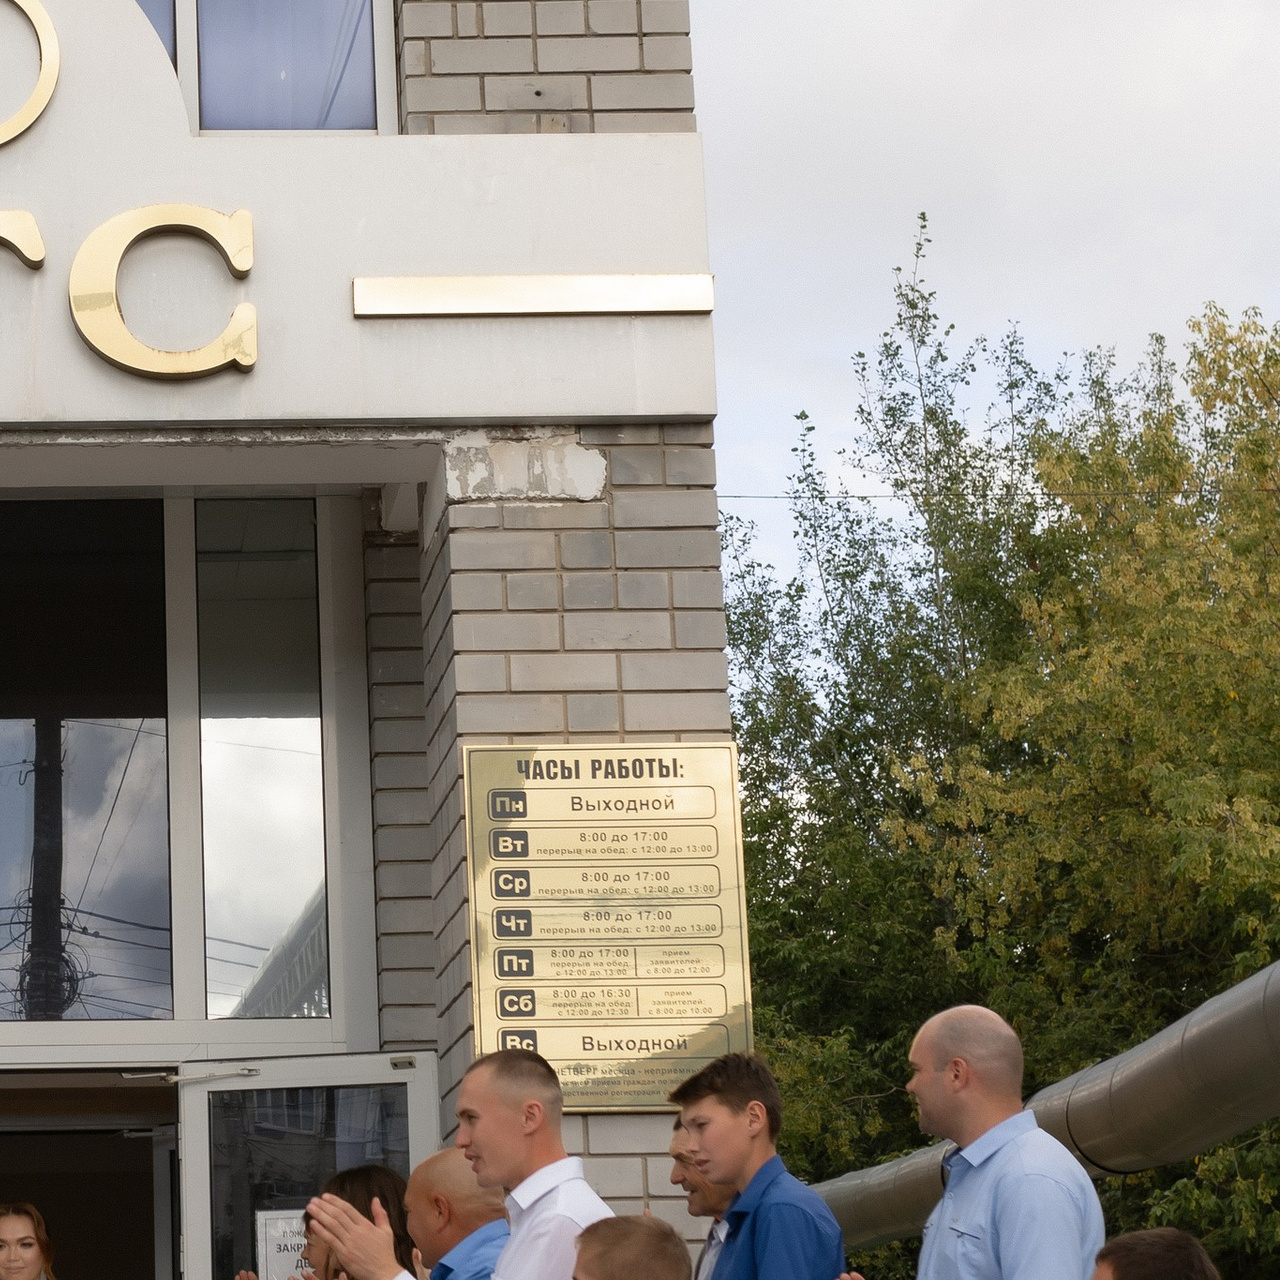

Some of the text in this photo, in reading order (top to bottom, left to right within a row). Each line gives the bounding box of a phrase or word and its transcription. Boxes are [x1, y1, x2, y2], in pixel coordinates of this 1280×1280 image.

[517, 758, 684, 780] ЧАСЫ РАБОТЫ:
[496, 797, 523, 813] Пн
[571, 795, 674, 813] Выходной
[499, 837, 524, 852] Вт
[580, 832, 668, 843] 8:00 до 17:00
[601, 846, 628, 855] обед:
[499, 874, 527, 893] Ср
[582, 872, 670, 883] 8:00 до 17:00
[603, 886, 630, 895] обед:
[672, 886, 684, 894] до
[502, 916, 528, 931] Чт
[583, 911, 672, 922] 8:00 до 17:00
[540, 927, 585, 935] перерыв
[604, 926, 632, 934] обед:
[691, 924, 716, 932] 13:00
[551, 949, 575, 958] 8:00
[599, 949, 629, 957] 17:00
[503, 955, 529, 972] Пт
[553, 990, 631, 999] 8:00 до 16:30
[504, 996, 533, 1012] Сб
[506, 1035, 534, 1051] Вс
[582, 1034, 688, 1053] Выходной
